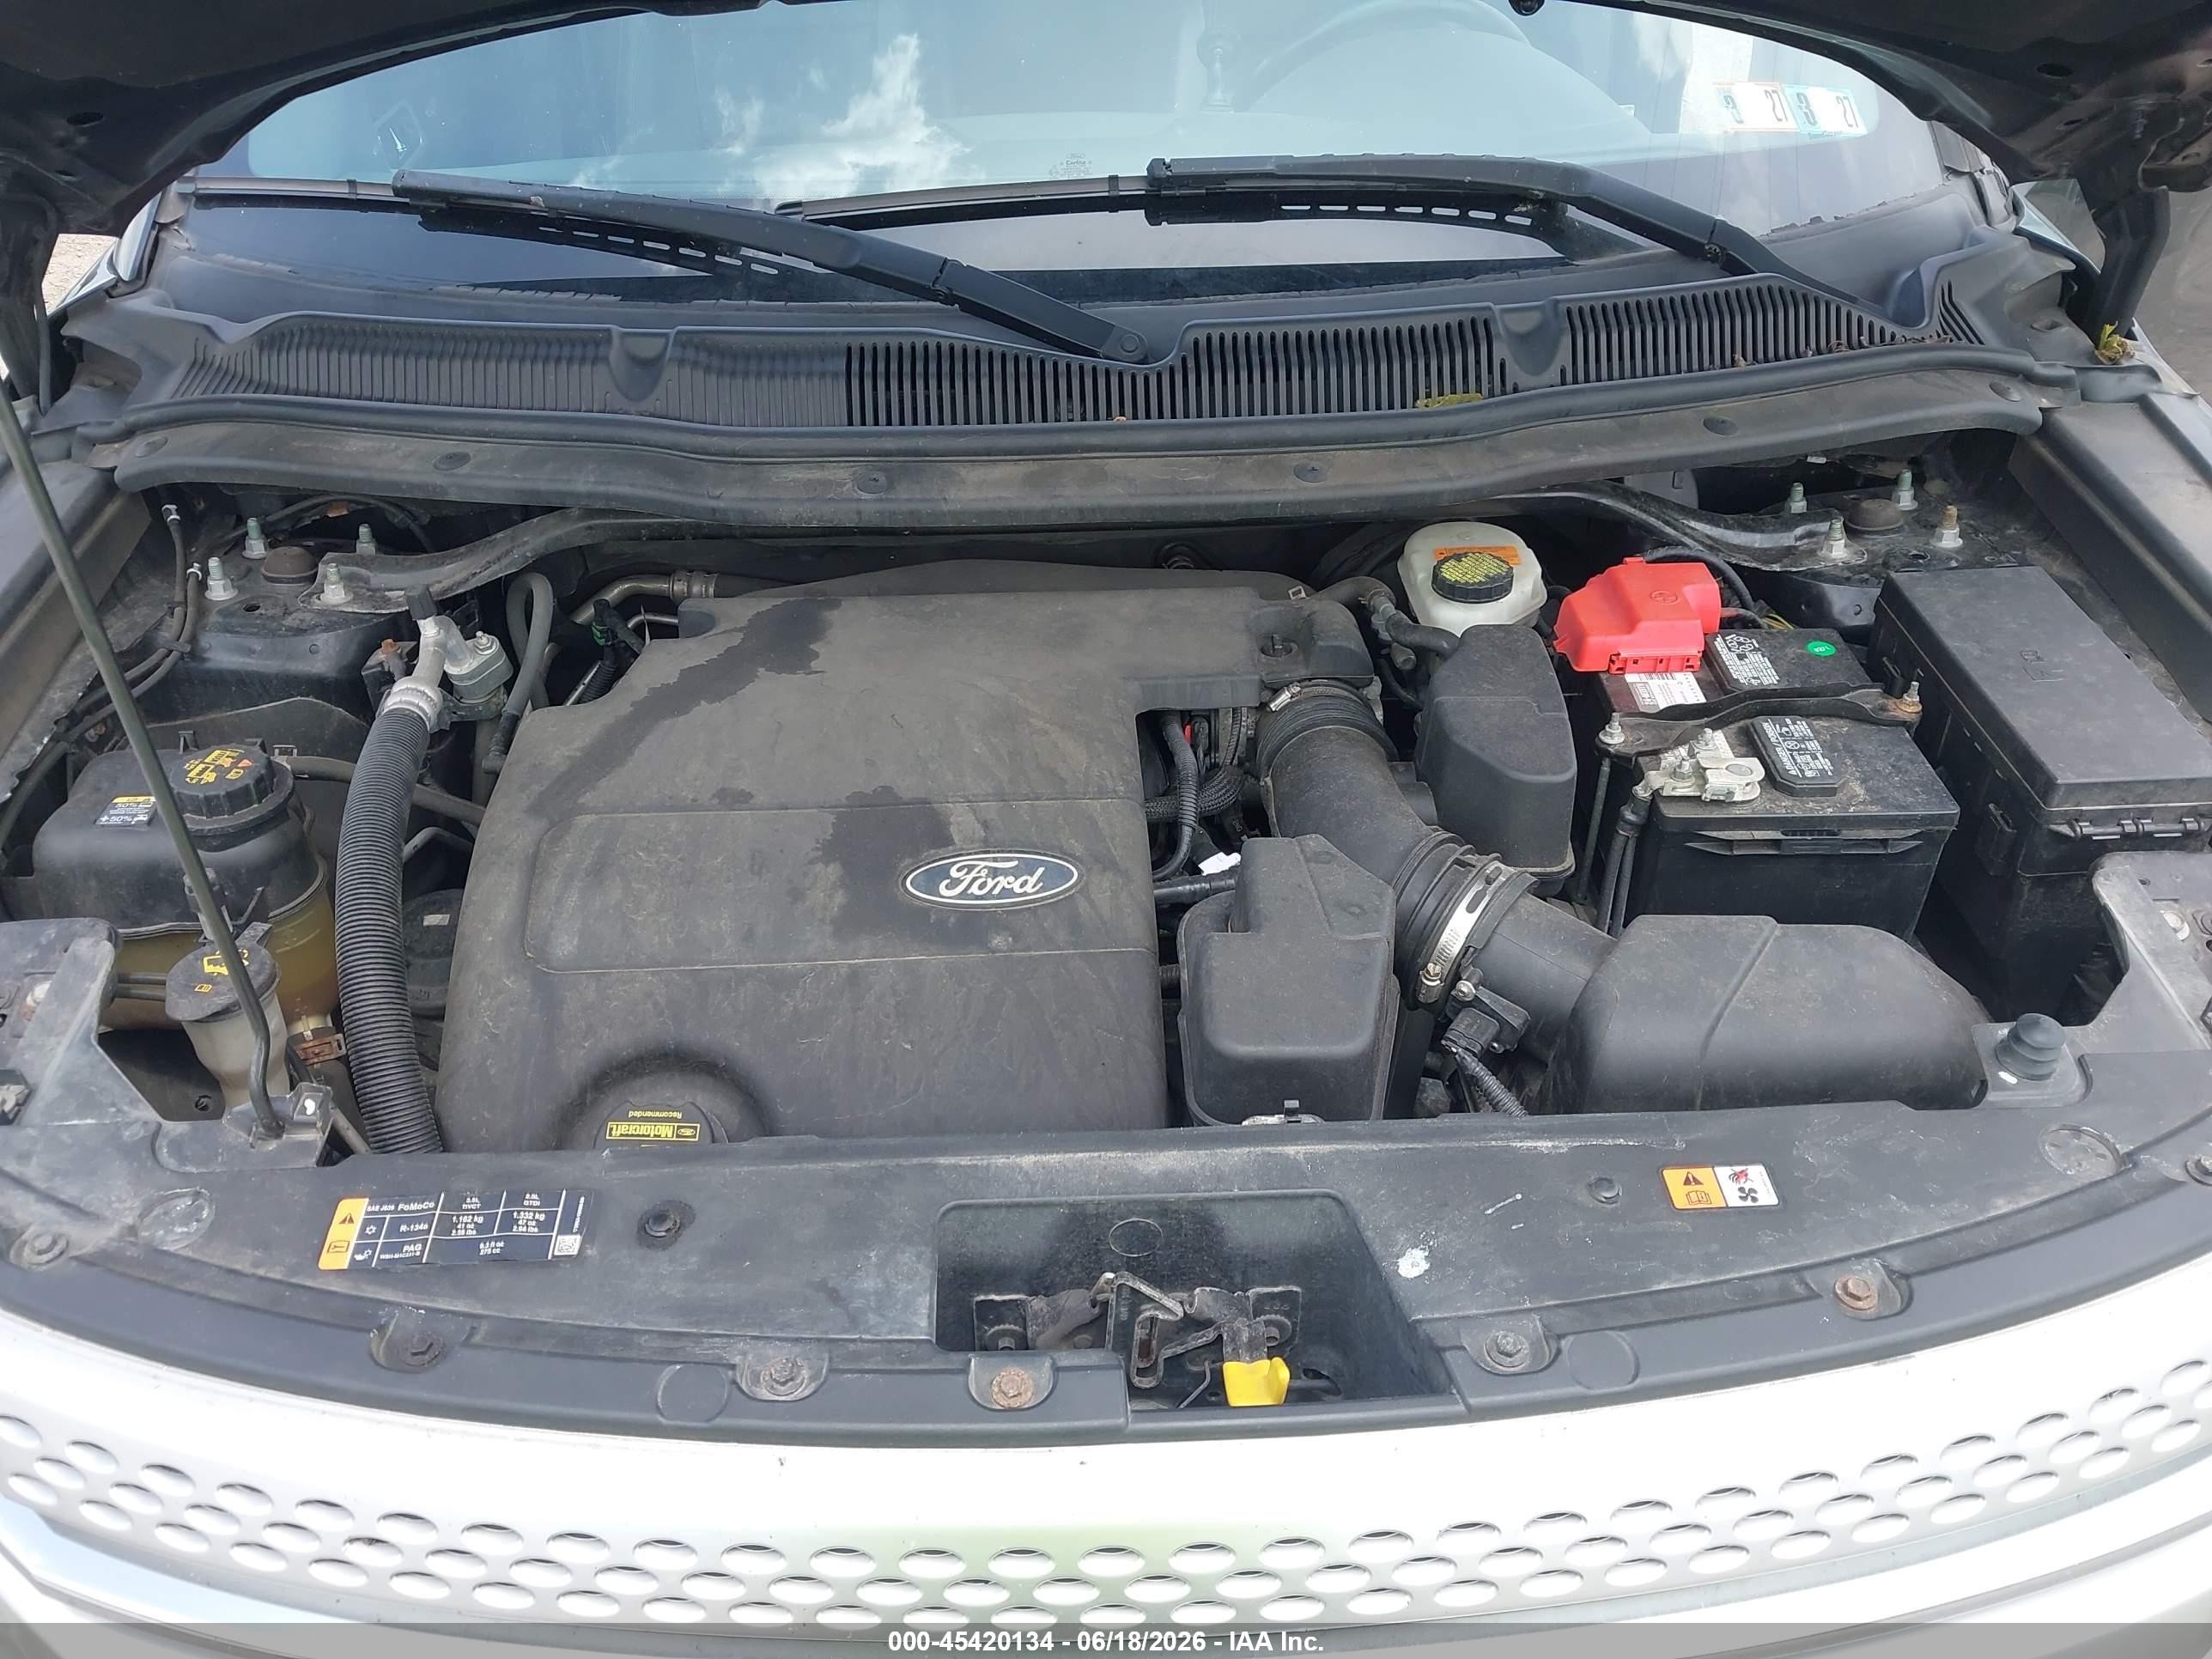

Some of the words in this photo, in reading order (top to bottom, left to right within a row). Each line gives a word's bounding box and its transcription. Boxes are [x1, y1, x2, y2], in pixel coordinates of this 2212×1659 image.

[1764, 88, 1788, 122] 27
[1796, 92, 1818, 126] 3
[1835, 95, 1859, 128] 27
[939, 860, 1045, 897] Ford
[628, 1110, 683, 1120] Recommended
[611, 1124, 673, 1138] Motorcraft
[398, 1201, 435, 1212] FoMoCo
[473, 1214, 484, 1224] kg
[513, 1211, 533, 1220] 1.332
[534, 1211, 546, 1221] kg
[399, 1223, 428, 1233] R-134a
[402, 1243, 422, 1253] PAG
